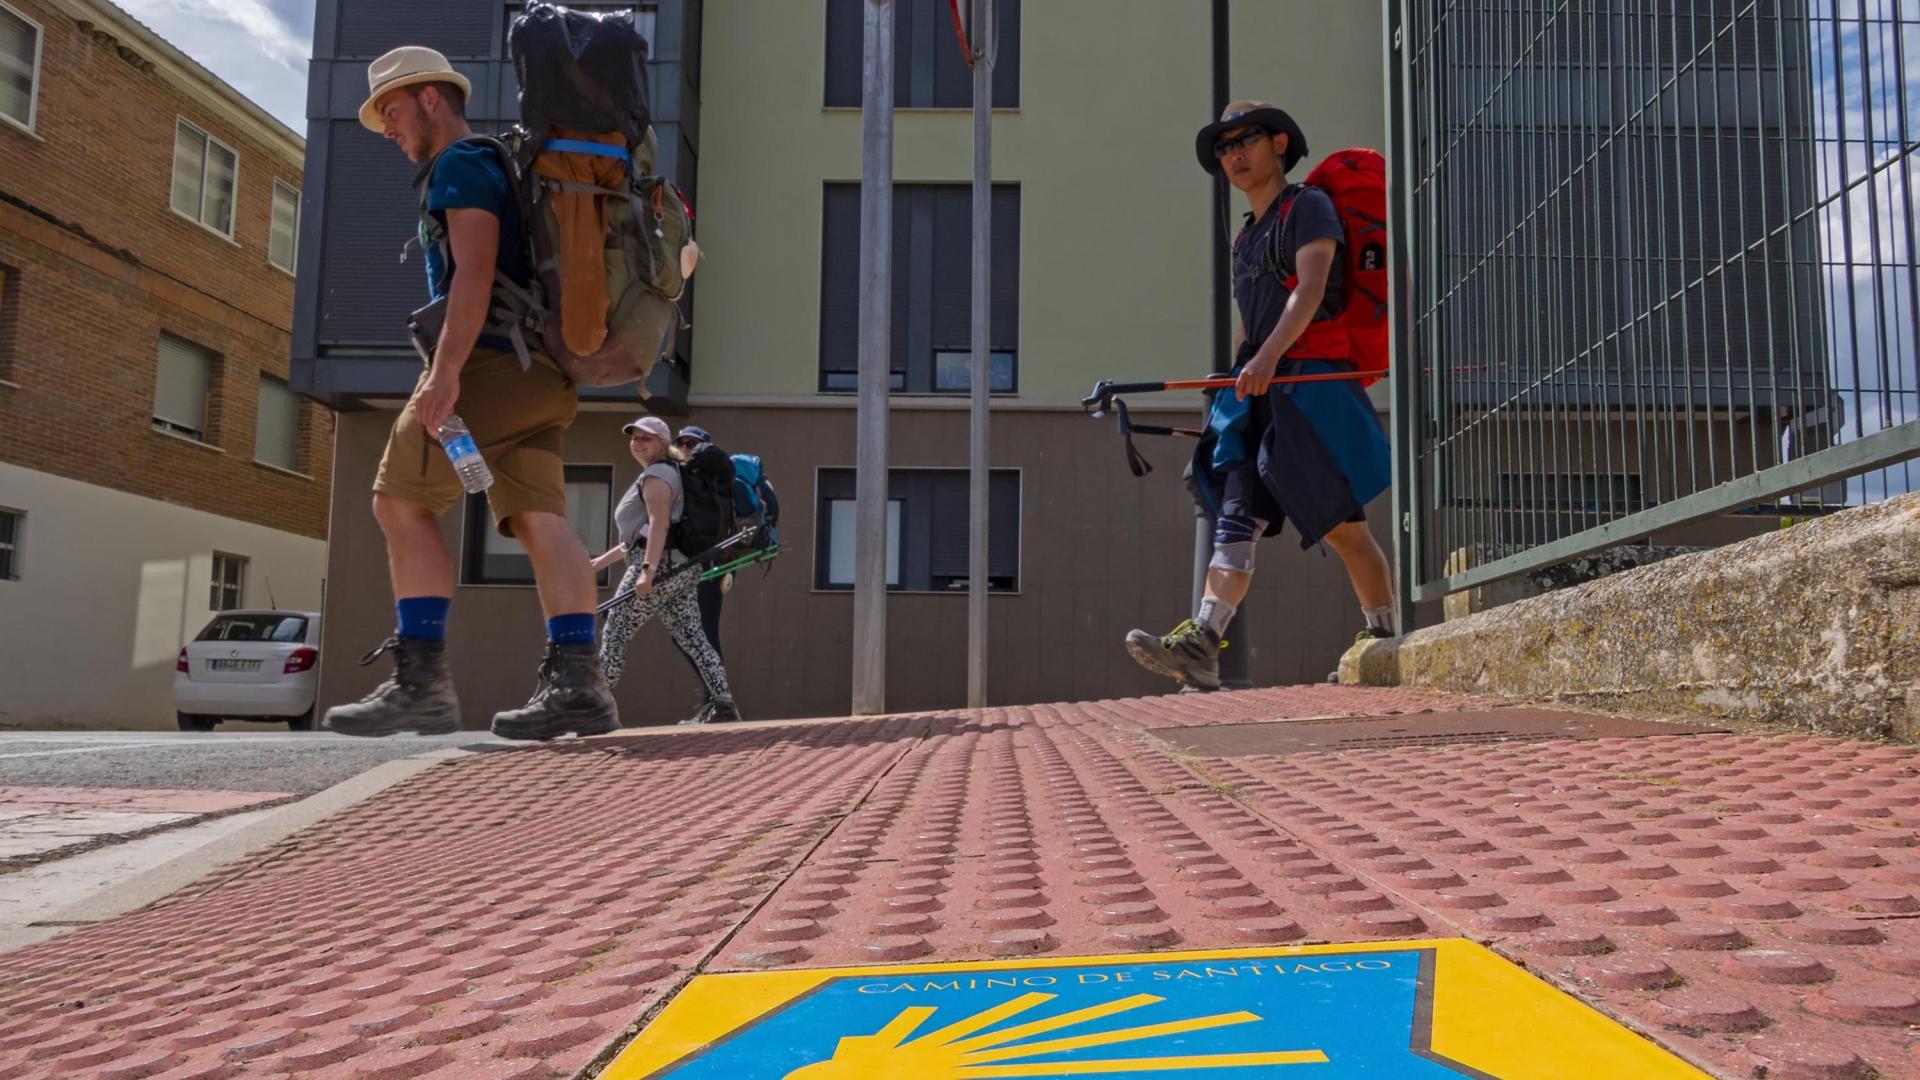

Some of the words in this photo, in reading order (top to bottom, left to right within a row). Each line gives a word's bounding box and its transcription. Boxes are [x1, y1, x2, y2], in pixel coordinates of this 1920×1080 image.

[858, 976, 1057, 994] CAMINO
[1077, 971, 1135, 985] DE
[1152, 960, 1392, 981] SANTIAGO
